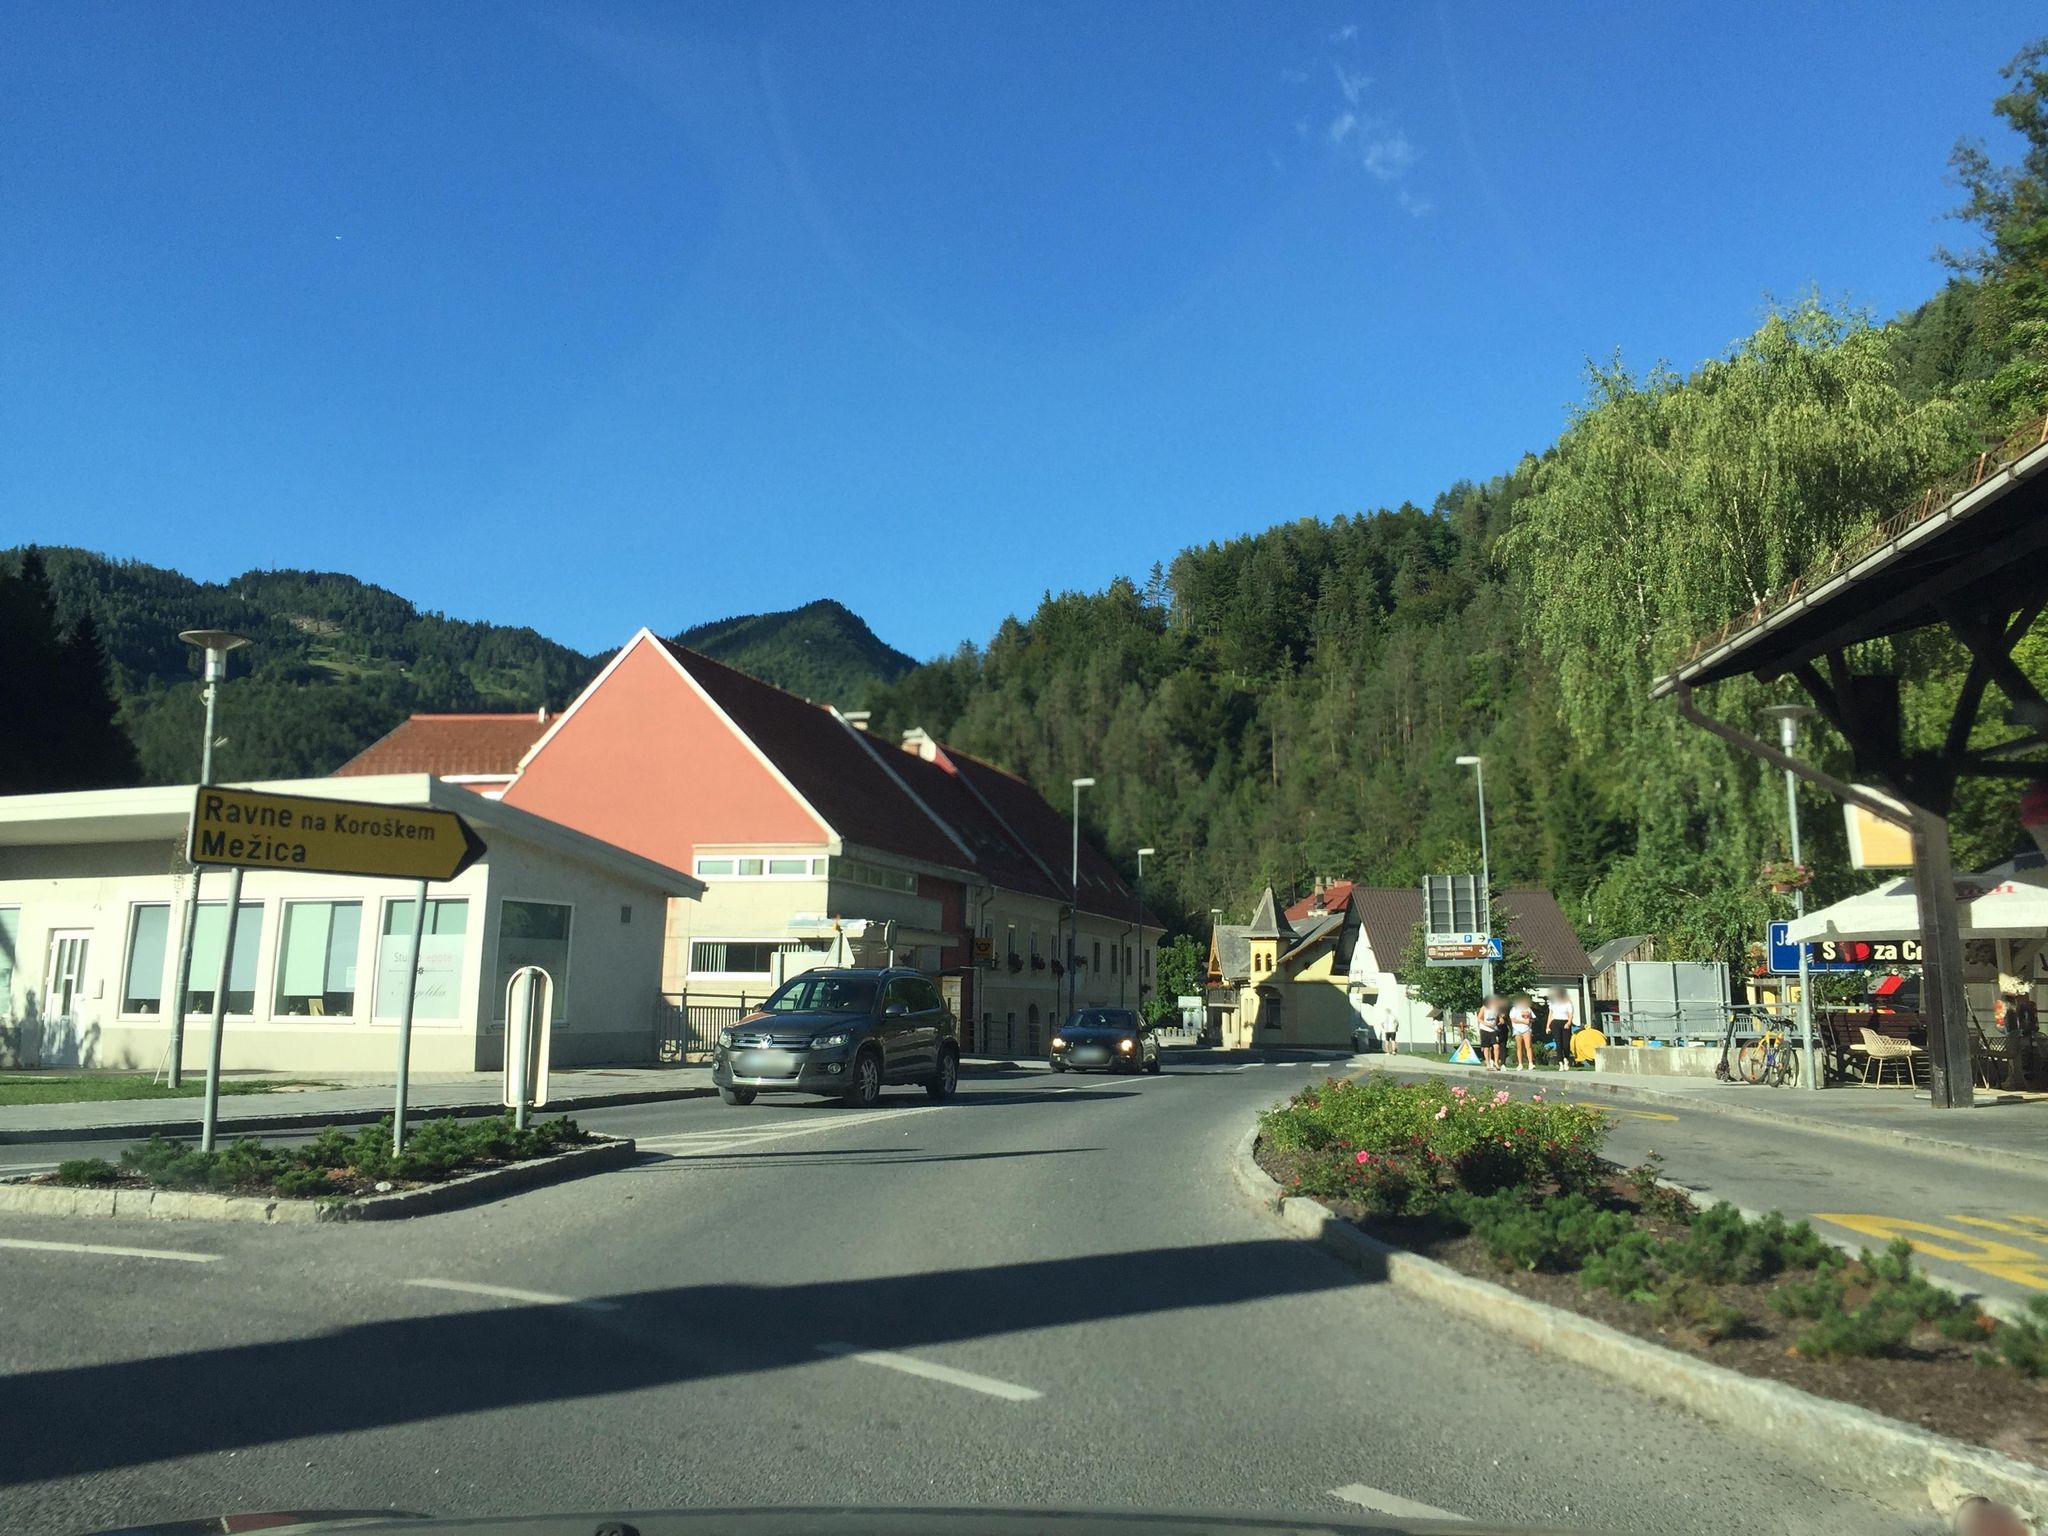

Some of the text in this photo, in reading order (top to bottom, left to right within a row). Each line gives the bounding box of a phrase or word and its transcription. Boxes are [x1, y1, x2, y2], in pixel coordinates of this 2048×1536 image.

[205, 795, 435, 840] Ravne na Koroškem
[201, 830, 306, 862] Mežica
[1822, 940, 1837, 960] S
[1873, 944, 1898, 960] za
